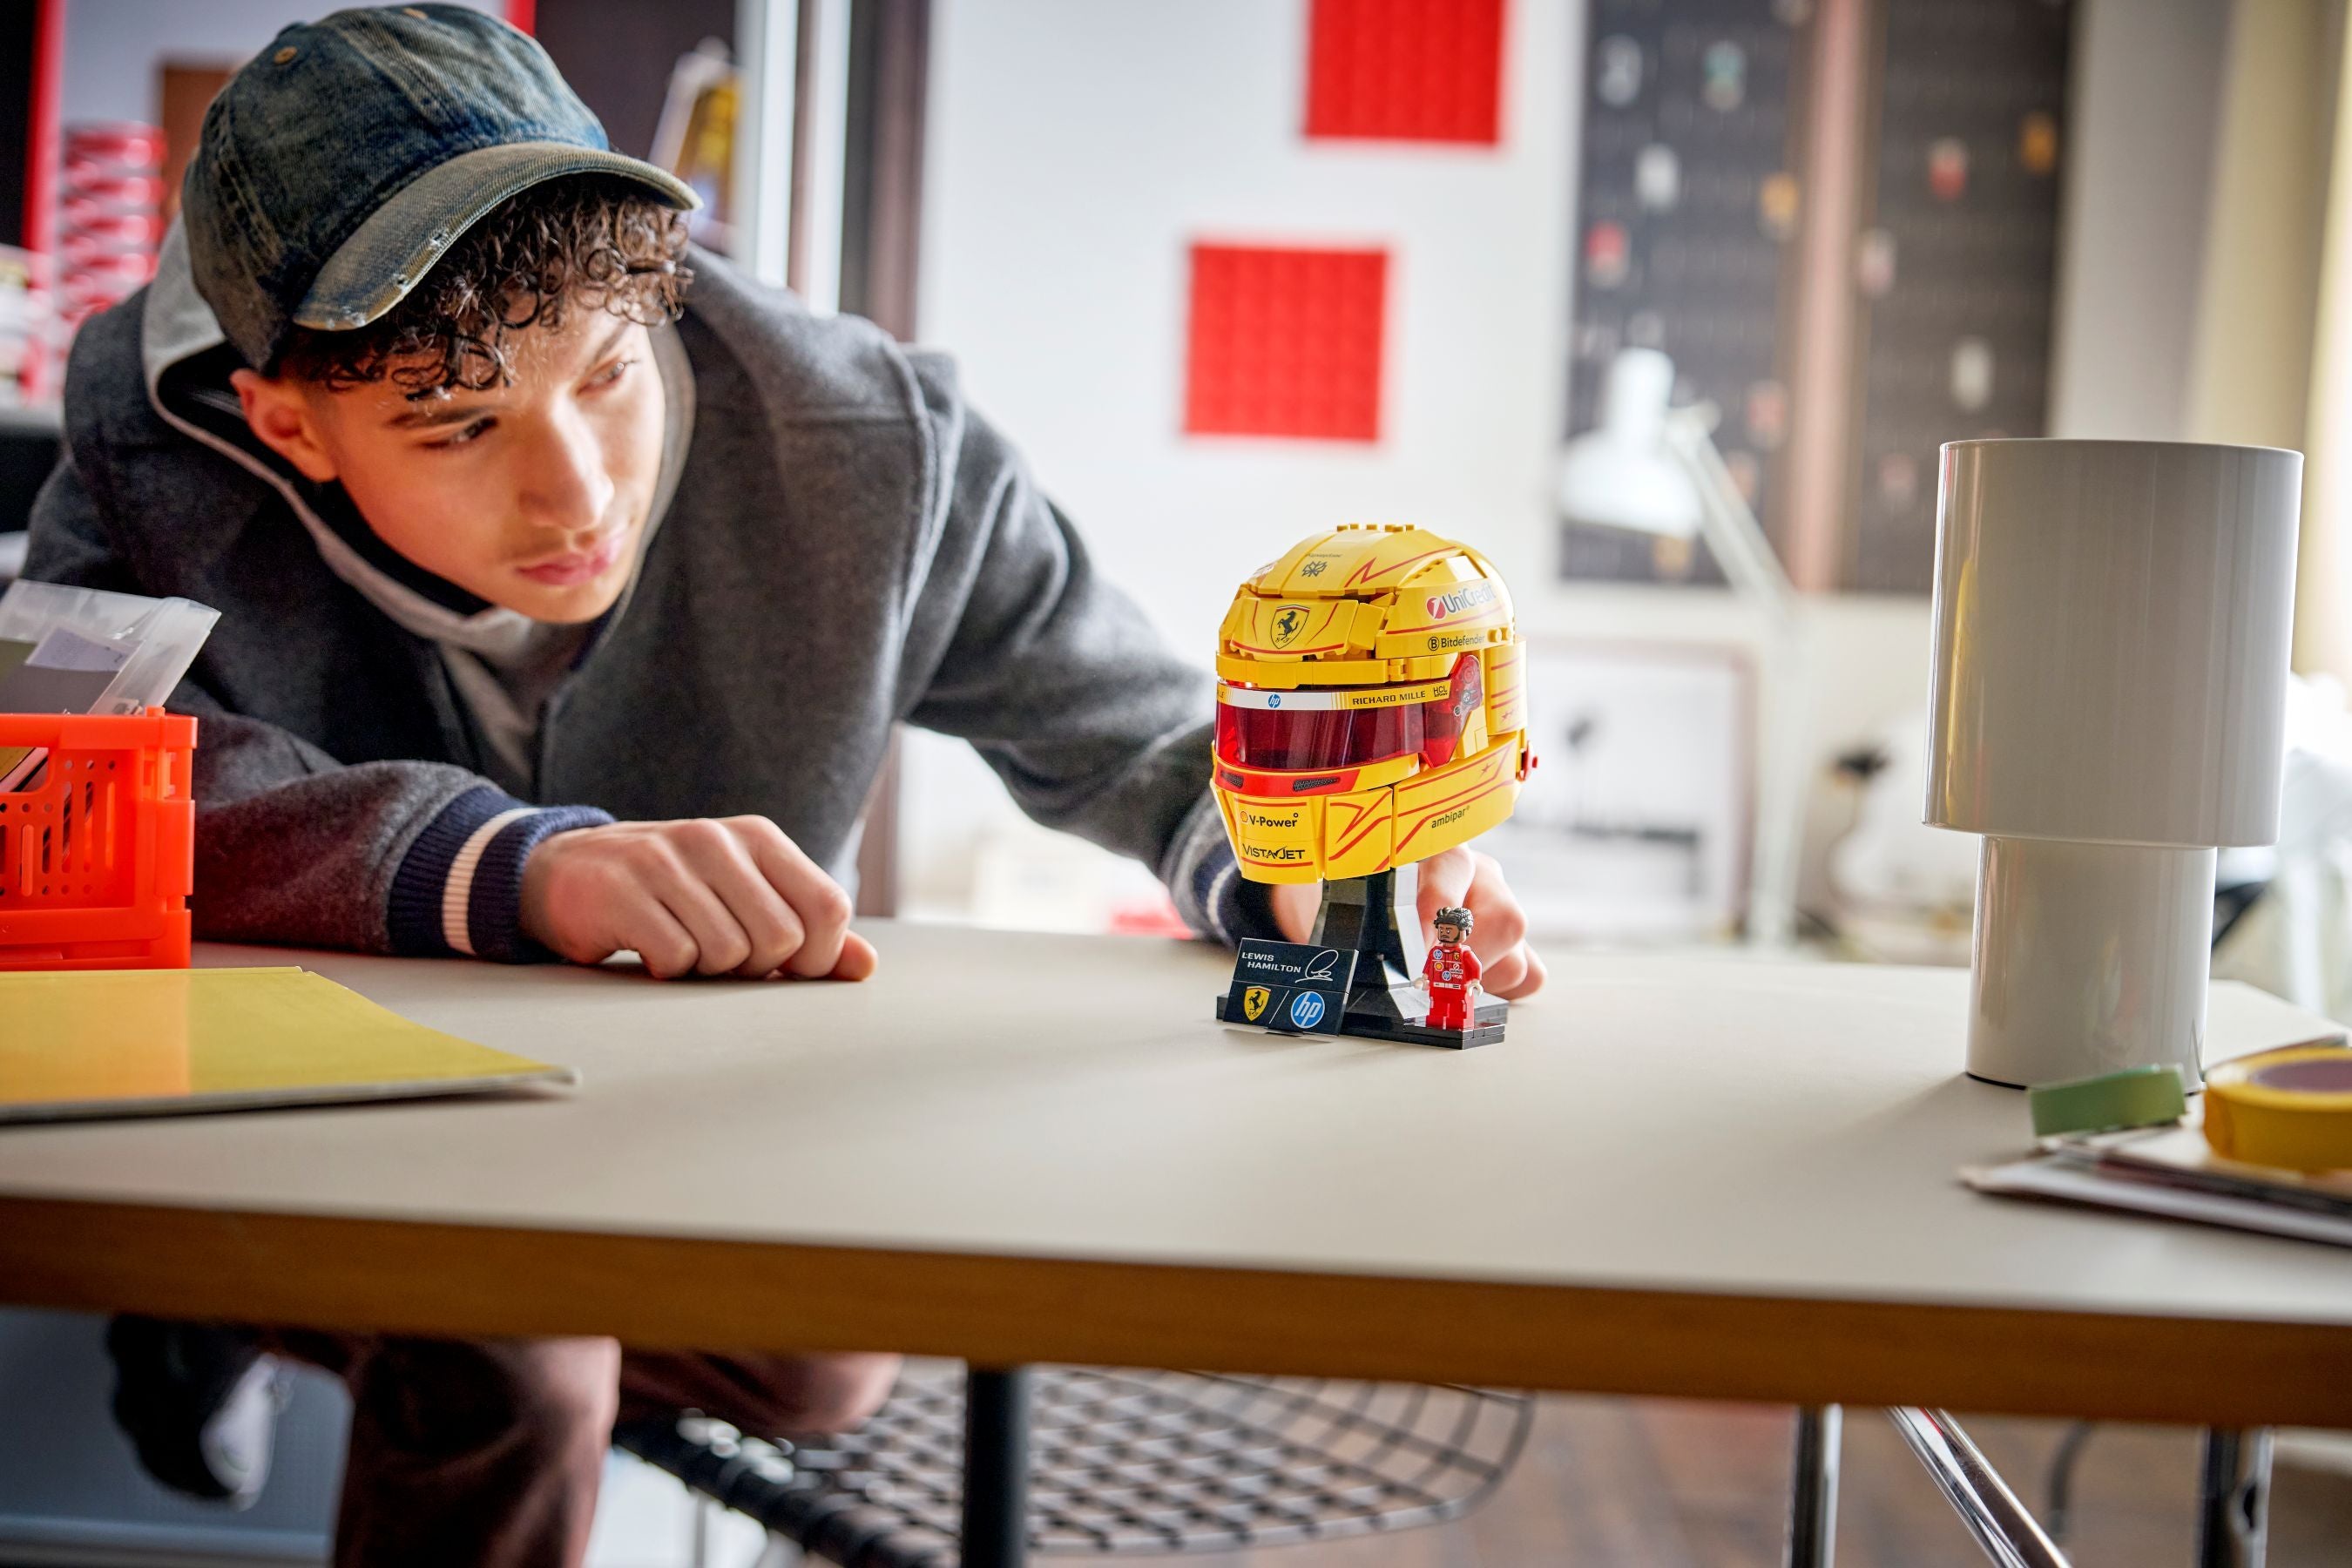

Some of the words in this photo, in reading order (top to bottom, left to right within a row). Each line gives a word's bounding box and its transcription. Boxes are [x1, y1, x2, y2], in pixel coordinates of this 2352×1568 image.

[1443, 583, 1496, 613] UniCredit
[1441, 634, 1484, 648] Bitdefender
[1433, 686, 1448, 694] HCL
[1269, 694, 1281, 708] hp
[1352, 694, 1396, 705] RICHARD
[1399, 691, 1426, 701] MILLE
[1249, 814, 1298, 828] V-Power
[1241, 951, 1274, 962] LEWIS
[1247, 961, 1301, 973] HAMILTON
[1293, 991, 1323, 1028] hp
